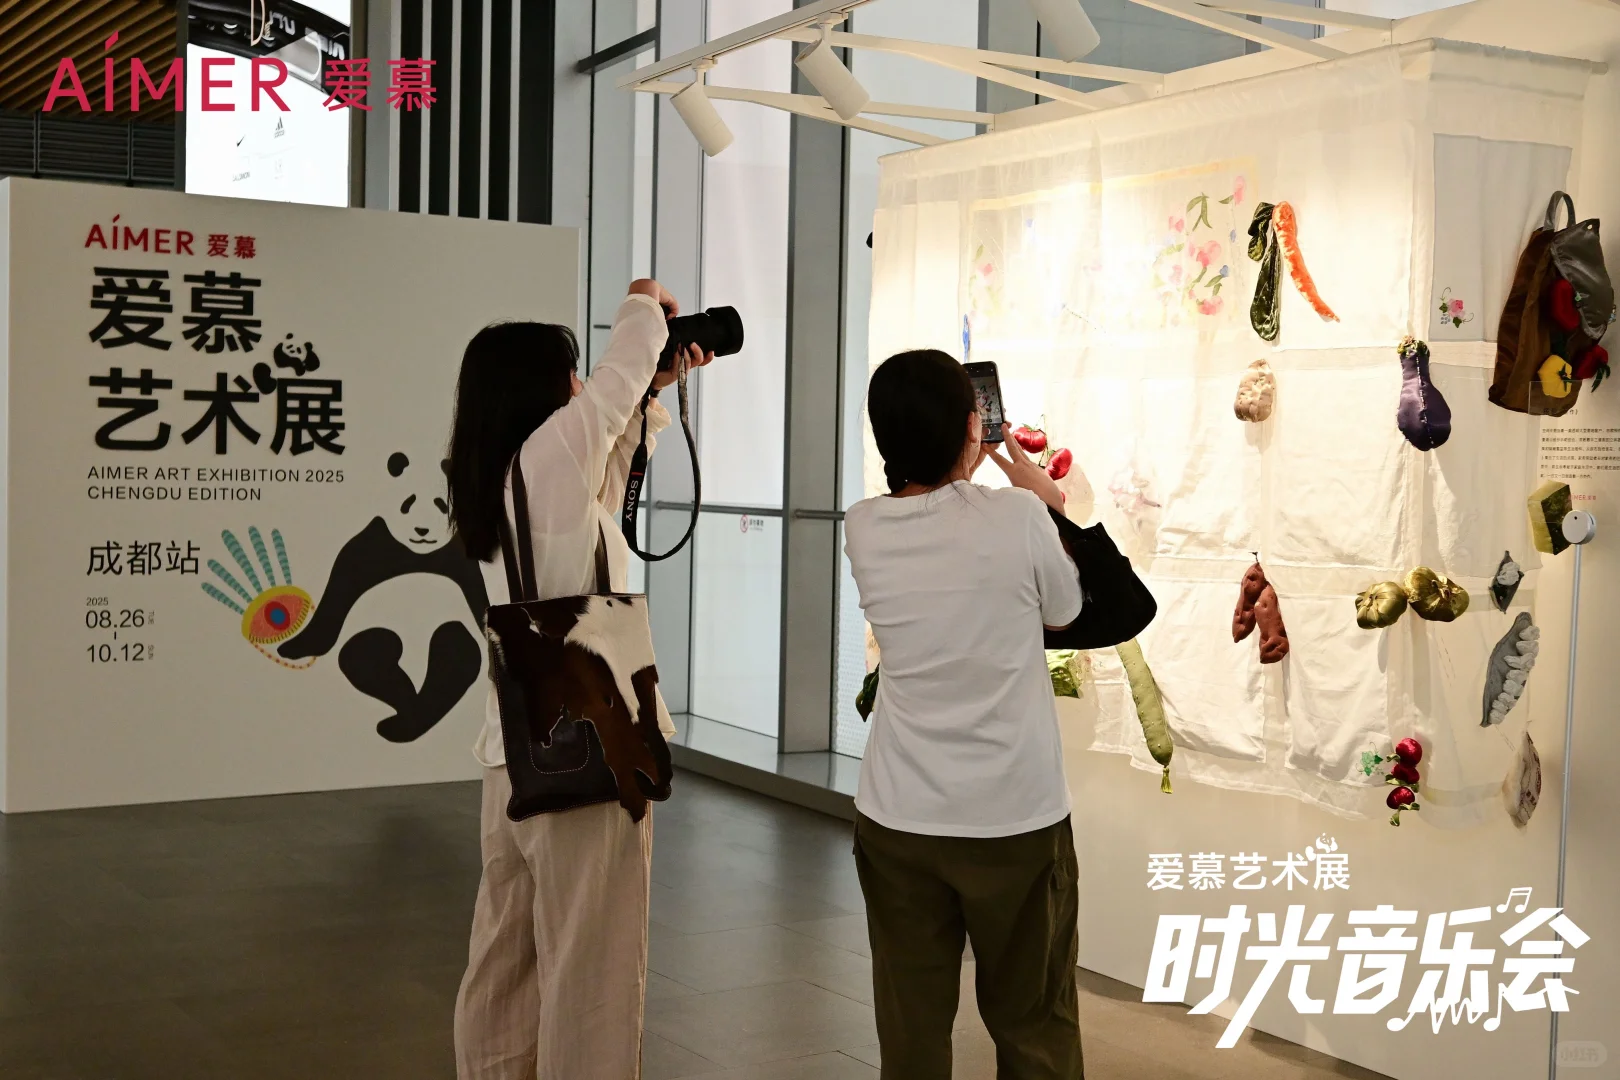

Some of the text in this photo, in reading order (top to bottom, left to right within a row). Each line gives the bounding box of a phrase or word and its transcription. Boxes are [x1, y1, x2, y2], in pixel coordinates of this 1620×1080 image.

[207, 233, 256, 259] 爱慕
[89, 266, 262, 354] 爱慕
[89, 367, 346, 456] 艺术展
[87, 466, 344, 483] AIMER ART EXHIBITION 2025
[87, 486, 261, 501] CHENGDU EDITION
[626, 480, 639, 522] SONY
[87, 540, 201, 576] 成都站
[86, 597, 109, 606] 2025
[85, 609, 145, 629] 08.26
[87, 643, 145, 663] 10.12
